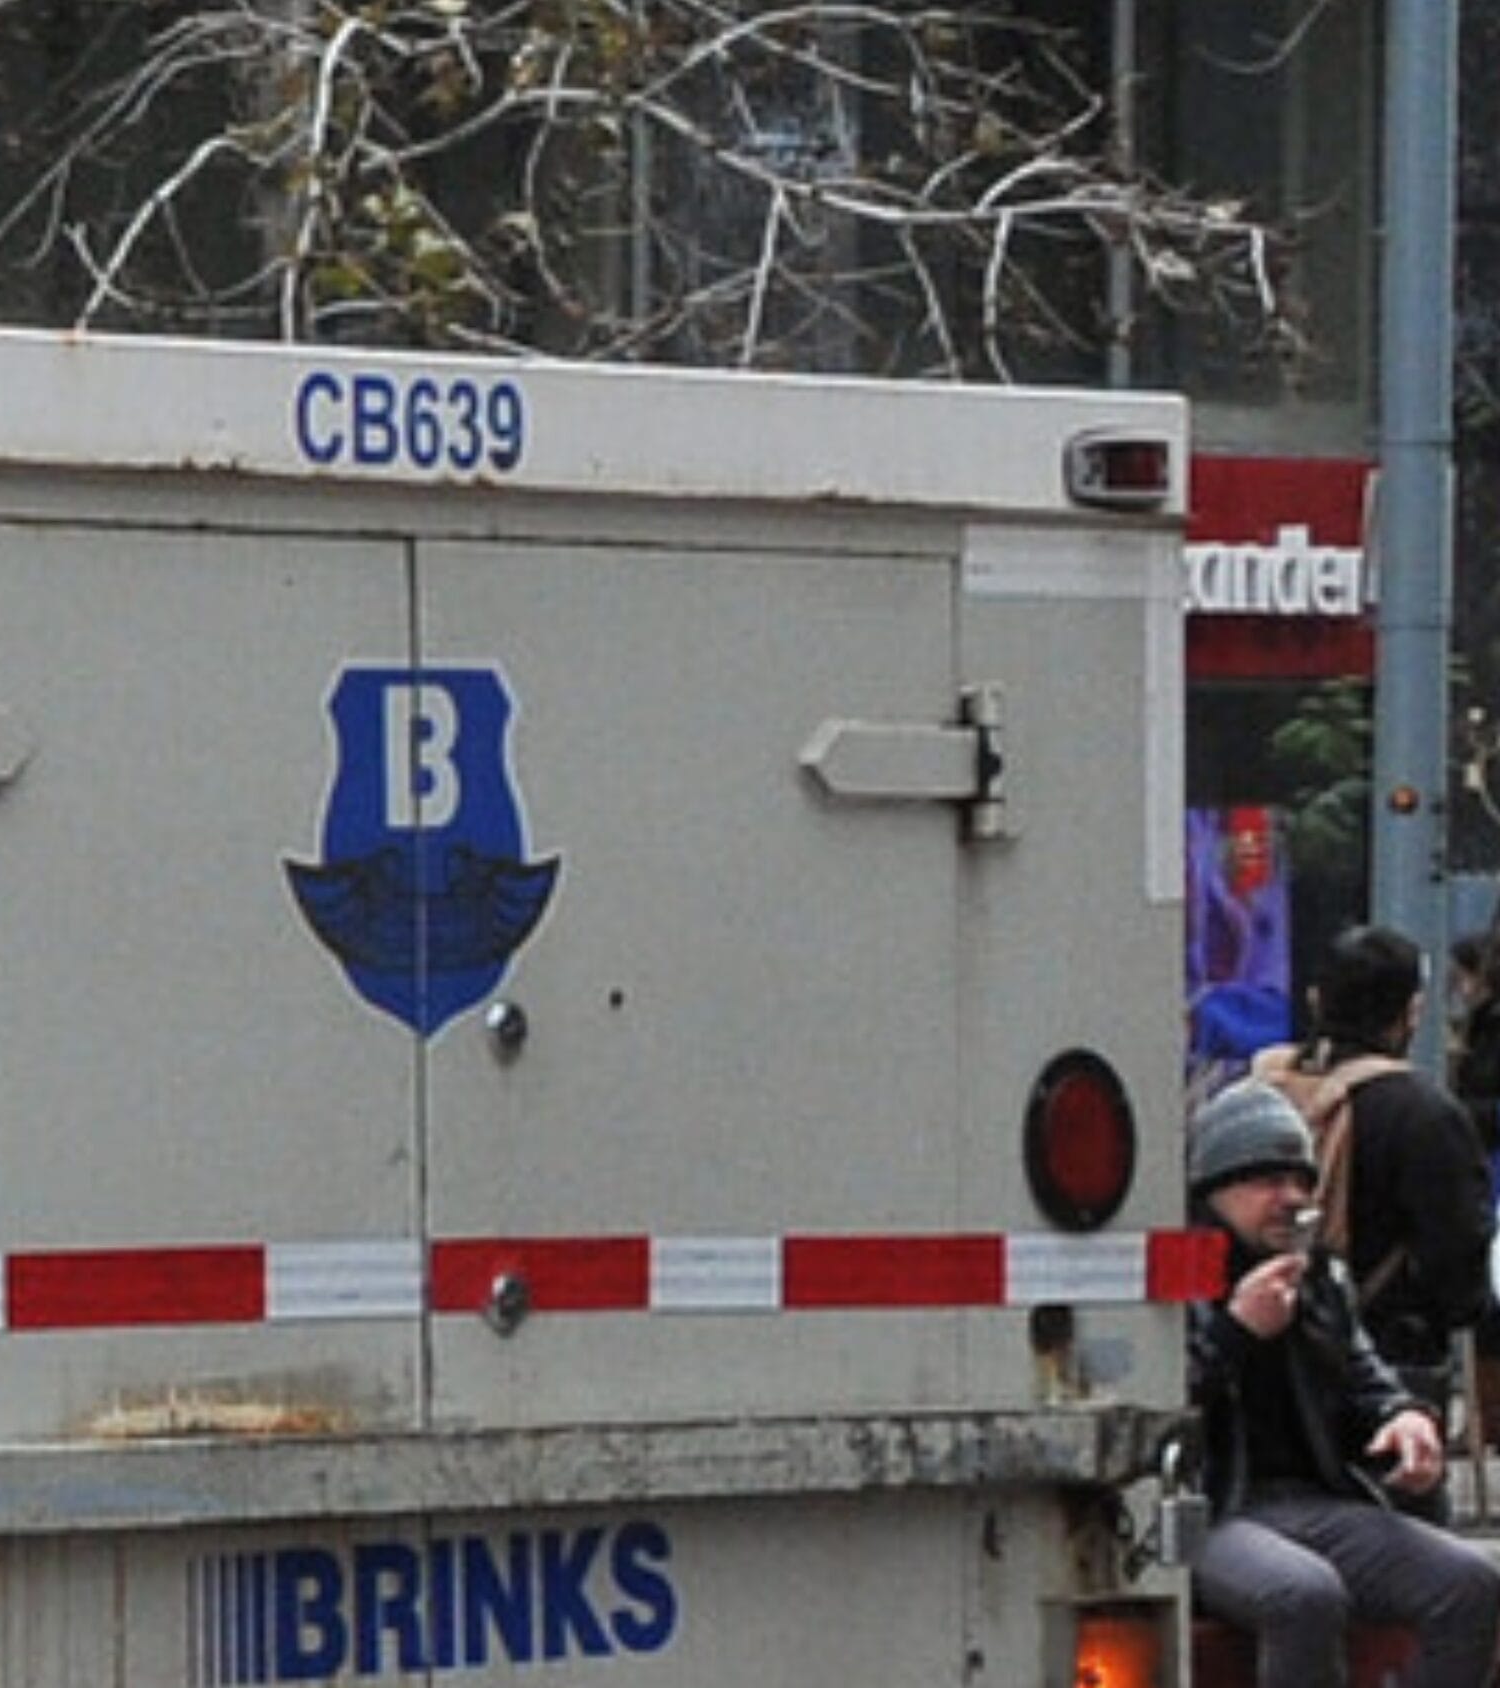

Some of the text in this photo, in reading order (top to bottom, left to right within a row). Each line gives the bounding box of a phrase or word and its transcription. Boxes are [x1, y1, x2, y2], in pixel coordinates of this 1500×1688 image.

[296, 372, 524, 472] CB639
[1185, 522, 1364, 615] ander
[384, 684, 461, 829] B
[274, 1519, 678, 1683] BRINKS
